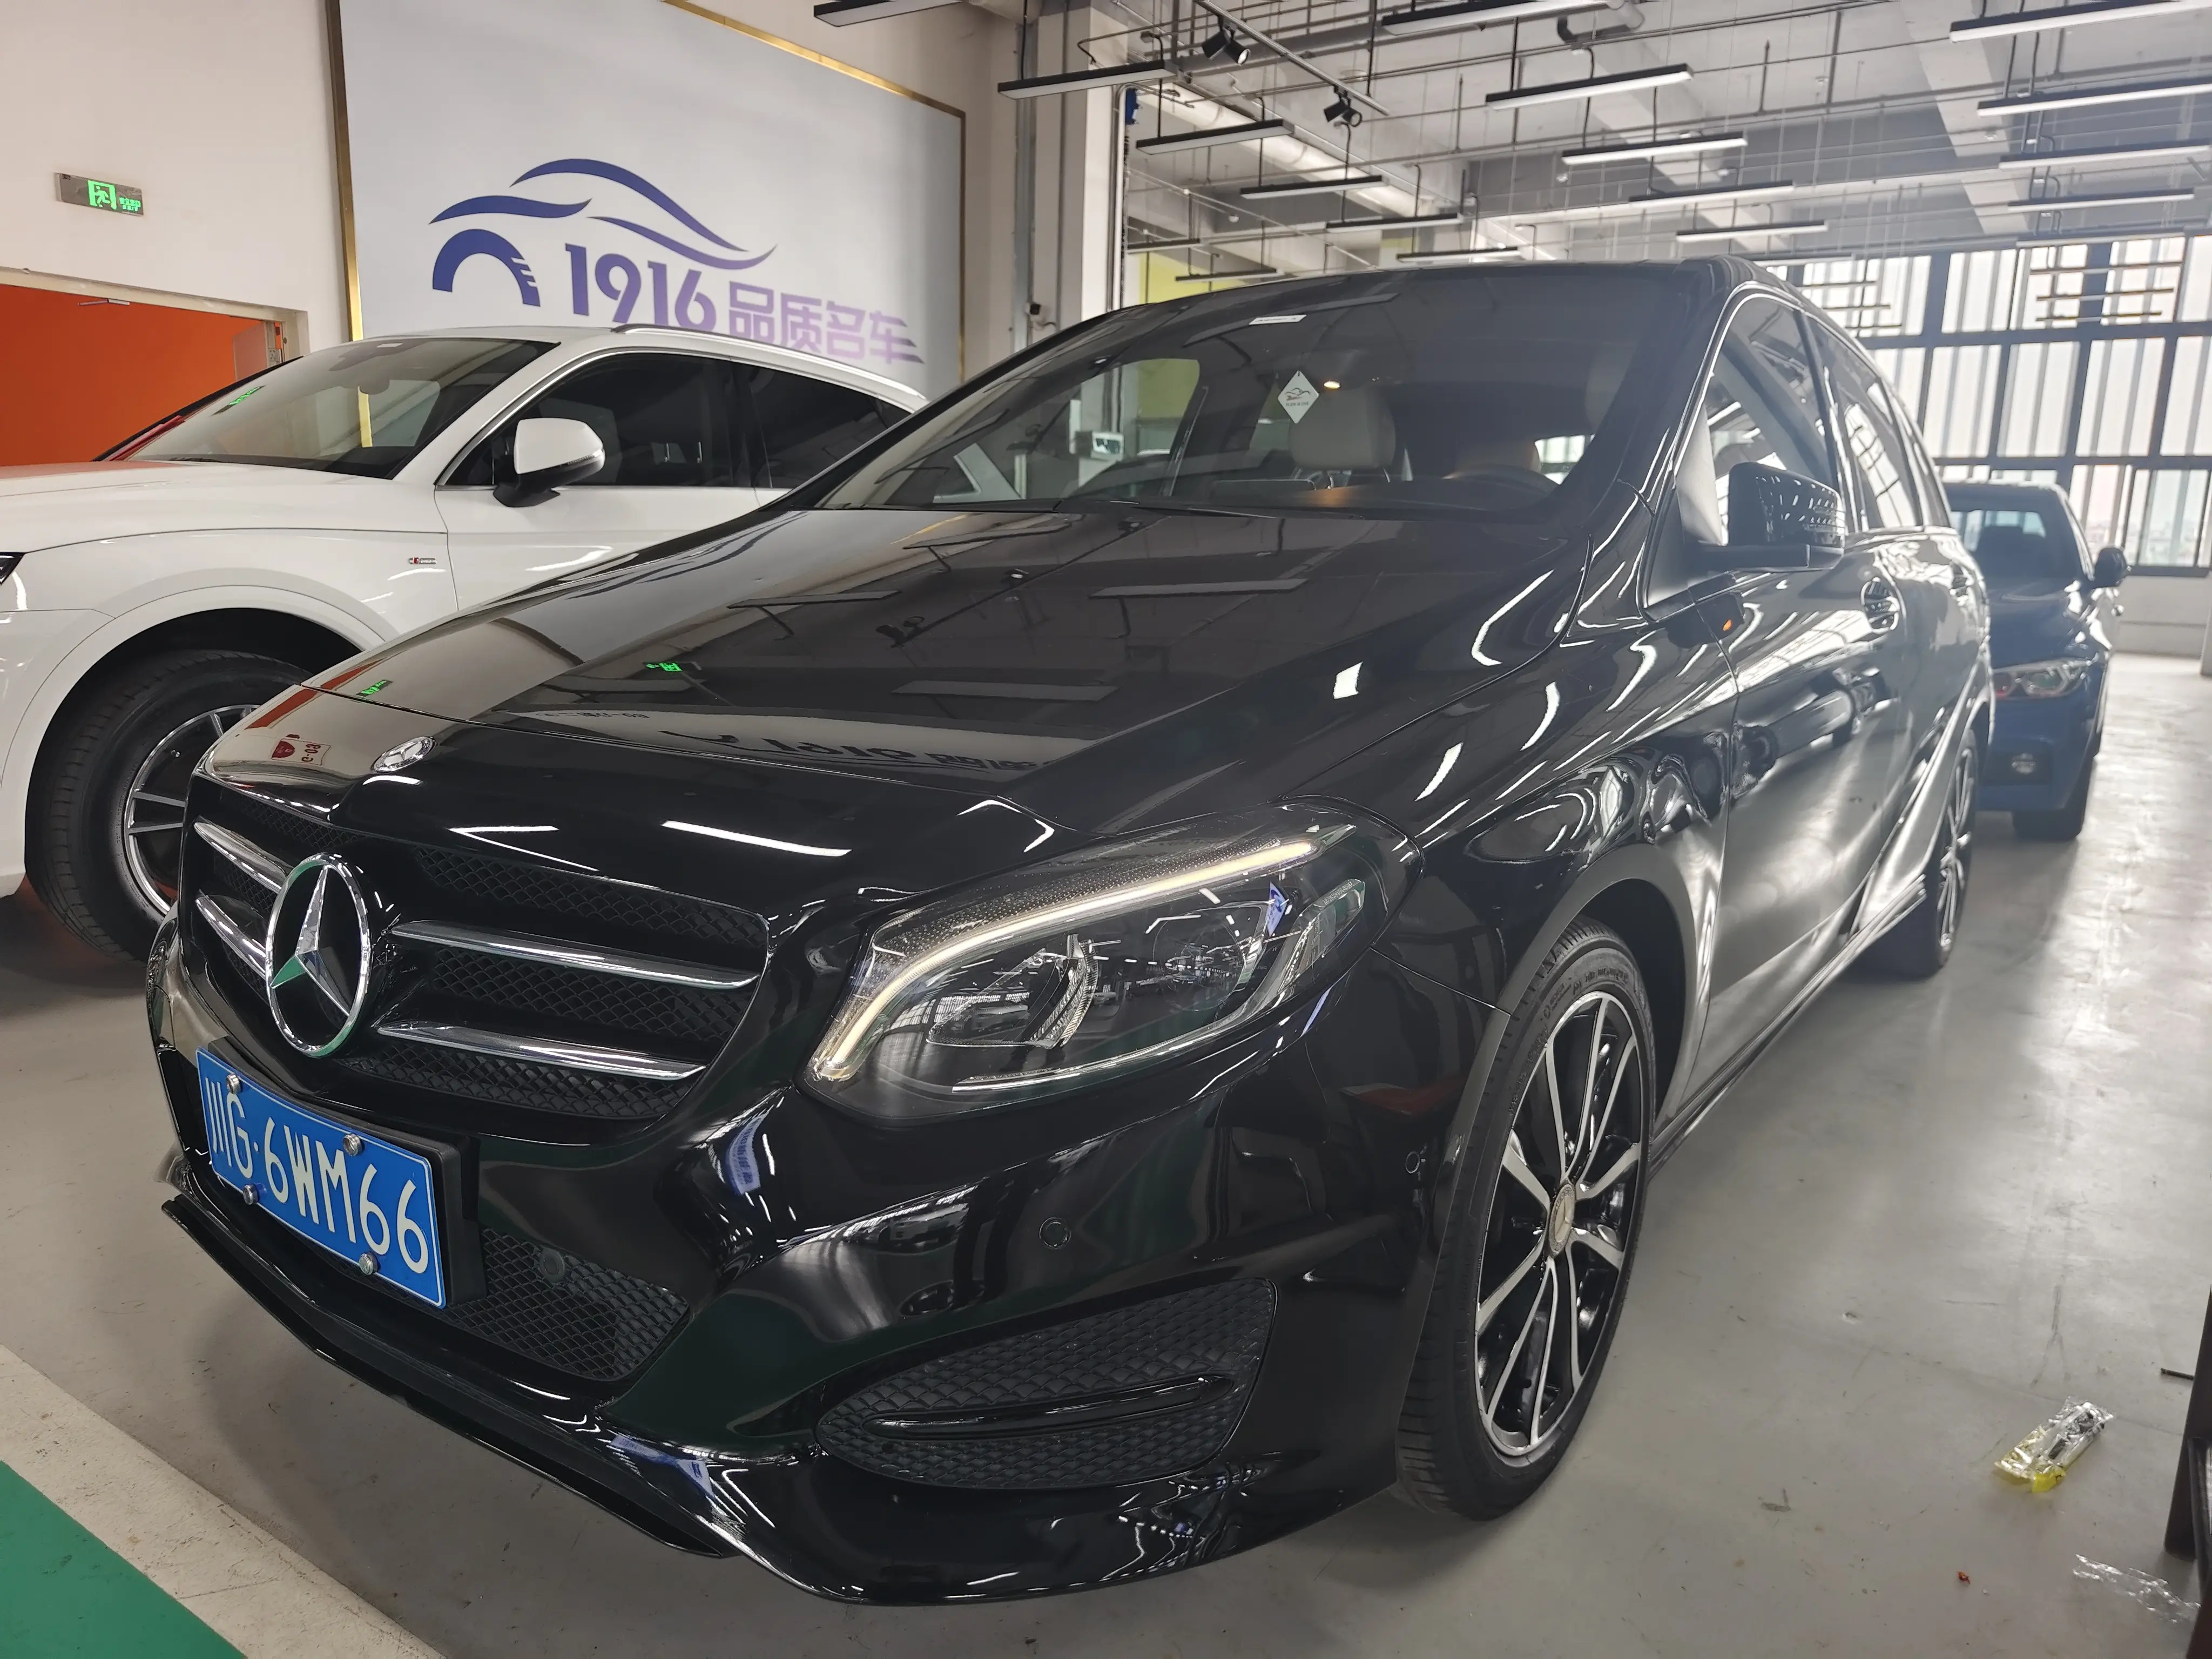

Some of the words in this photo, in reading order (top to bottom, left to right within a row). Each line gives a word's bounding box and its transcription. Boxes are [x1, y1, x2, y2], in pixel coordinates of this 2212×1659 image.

[565, 243, 717, 332] 1916
[729, 281, 924, 365] 品质名车
